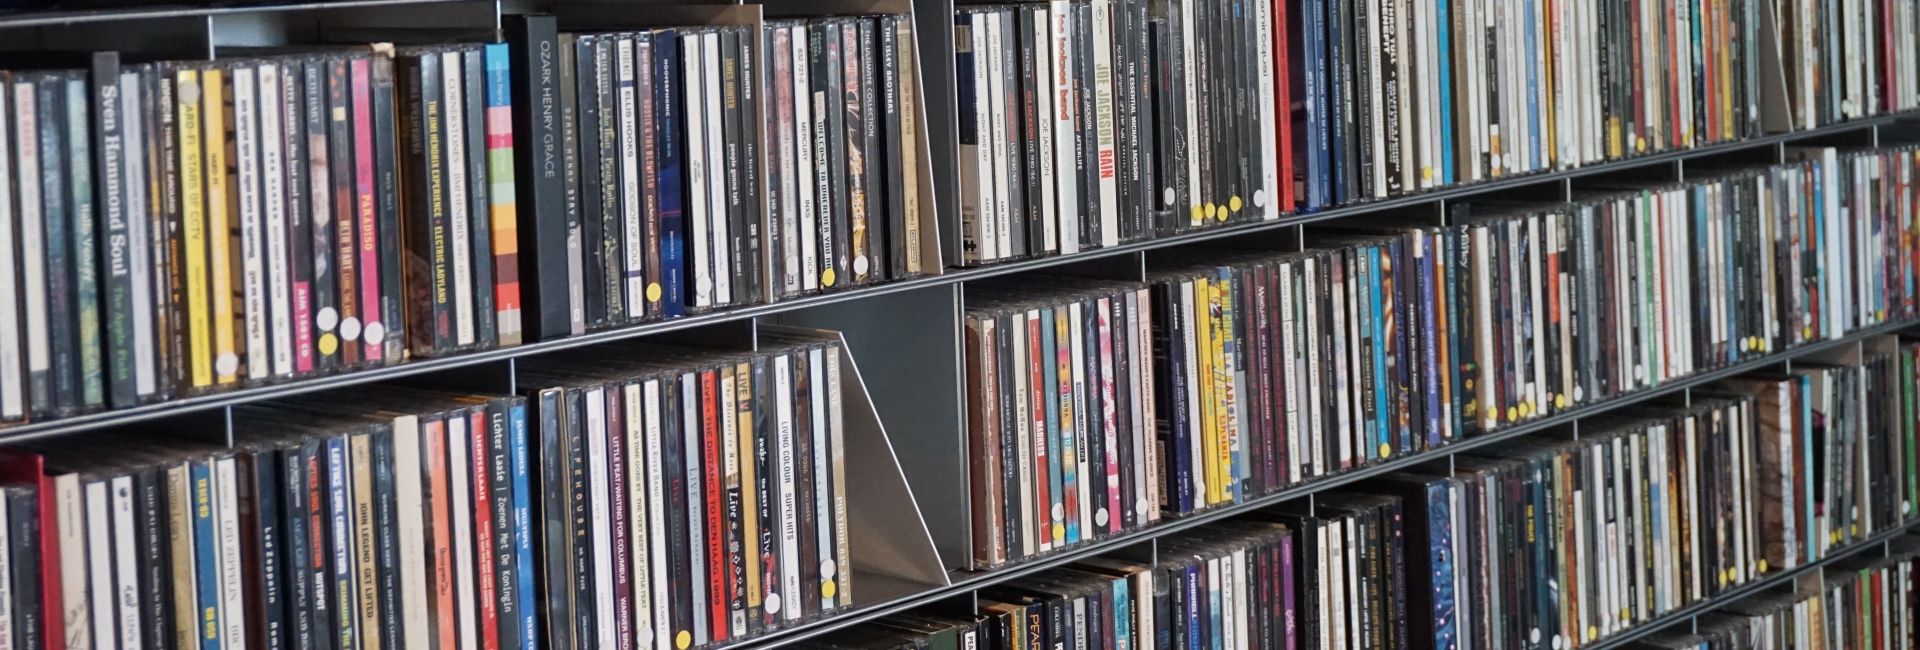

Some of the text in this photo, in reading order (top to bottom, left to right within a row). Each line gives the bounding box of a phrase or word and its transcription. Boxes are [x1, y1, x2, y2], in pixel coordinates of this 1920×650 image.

[622, 47, 631, 76] EVIDENCE
[725, 58, 733, 79] JAMES
[1055, 14, 1069, 120] joe jackson band
[308, 68, 318, 123] BETH HART
[541, 40, 554, 178] OZARK HENRY GRACE
[624, 91, 632, 118] ELLIS
[727, 82, 735, 109] HUNTER
[886, 71, 894, 113] BROTHERS
[22, 88, 32, 157] NINA HAGEN
[165, 126, 173, 146] THIS
[1096, 64, 1113, 178] JOE JACKSON RAIN
[166, 150, 174, 175] TIME
[448, 78, 464, 240] CORNERSTONES JIMI HENDRIX
[602, 107, 614, 208] John Hiatt Pirate Radio
[729, 144, 737, 167] people
[101, 86, 127, 276] Sven Hammond Soul
[167, 178, 176, 214] AROUND
[429, 100, 446, 303] THE JIMI HENDRIX EXPERIENCE ELECTRIC LADYLAND
[628, 182, 636, 222] GODSON
[361, 194, 372, 251] PARADISO
[630, 228, 637, 239] OF
[340, 220, 352, 270] BETH HART
[1460, 224, 1469, 268] Marley
[1258, 286, 1267, 328] MARILLION
[739, 372, 748, 410] LIVE V
[706, 415, 714, 437] THE
[781, 421, 789, 448] LIVING
[1036, 420, 1044, 457] MADNESS
[332, 448, 342, 487] LEFTIES
[707, 442, 716, 497] DISTANCE
[783, 451, 791, 483] COLOUR
[334, 491, 343, 514] SOUL
[360, 503, 368, 525] JOHN
[493, 413, 512, 612] Lichter Laaie Zoenen Met De Koningin
[710, 500, 717, 513] TO
[837, 496, 845, 544] POLYDOR
[225, 520, 235, 542] LED
[309, 456, 325, 610] LEFTIES SOUL CONNECTION HUTSPOT
[336, 516, 346, 574] CONNECTION
[362, 528, 370, 563] LEGEND
[710, 516, 718, 540] DEN
[227, 545, 237, 601] ZEPPELIN
[264, 527, 276, 603] Led Zeppelin
[618, 538, 626, 583] COLUMBUS
[712, 543, 720, 576] HAAG
[365, 588, 373, 618] LIFTED
[840, 570, 848, 597] 337-2
[340, 580, 349, 627] SKIMMING
